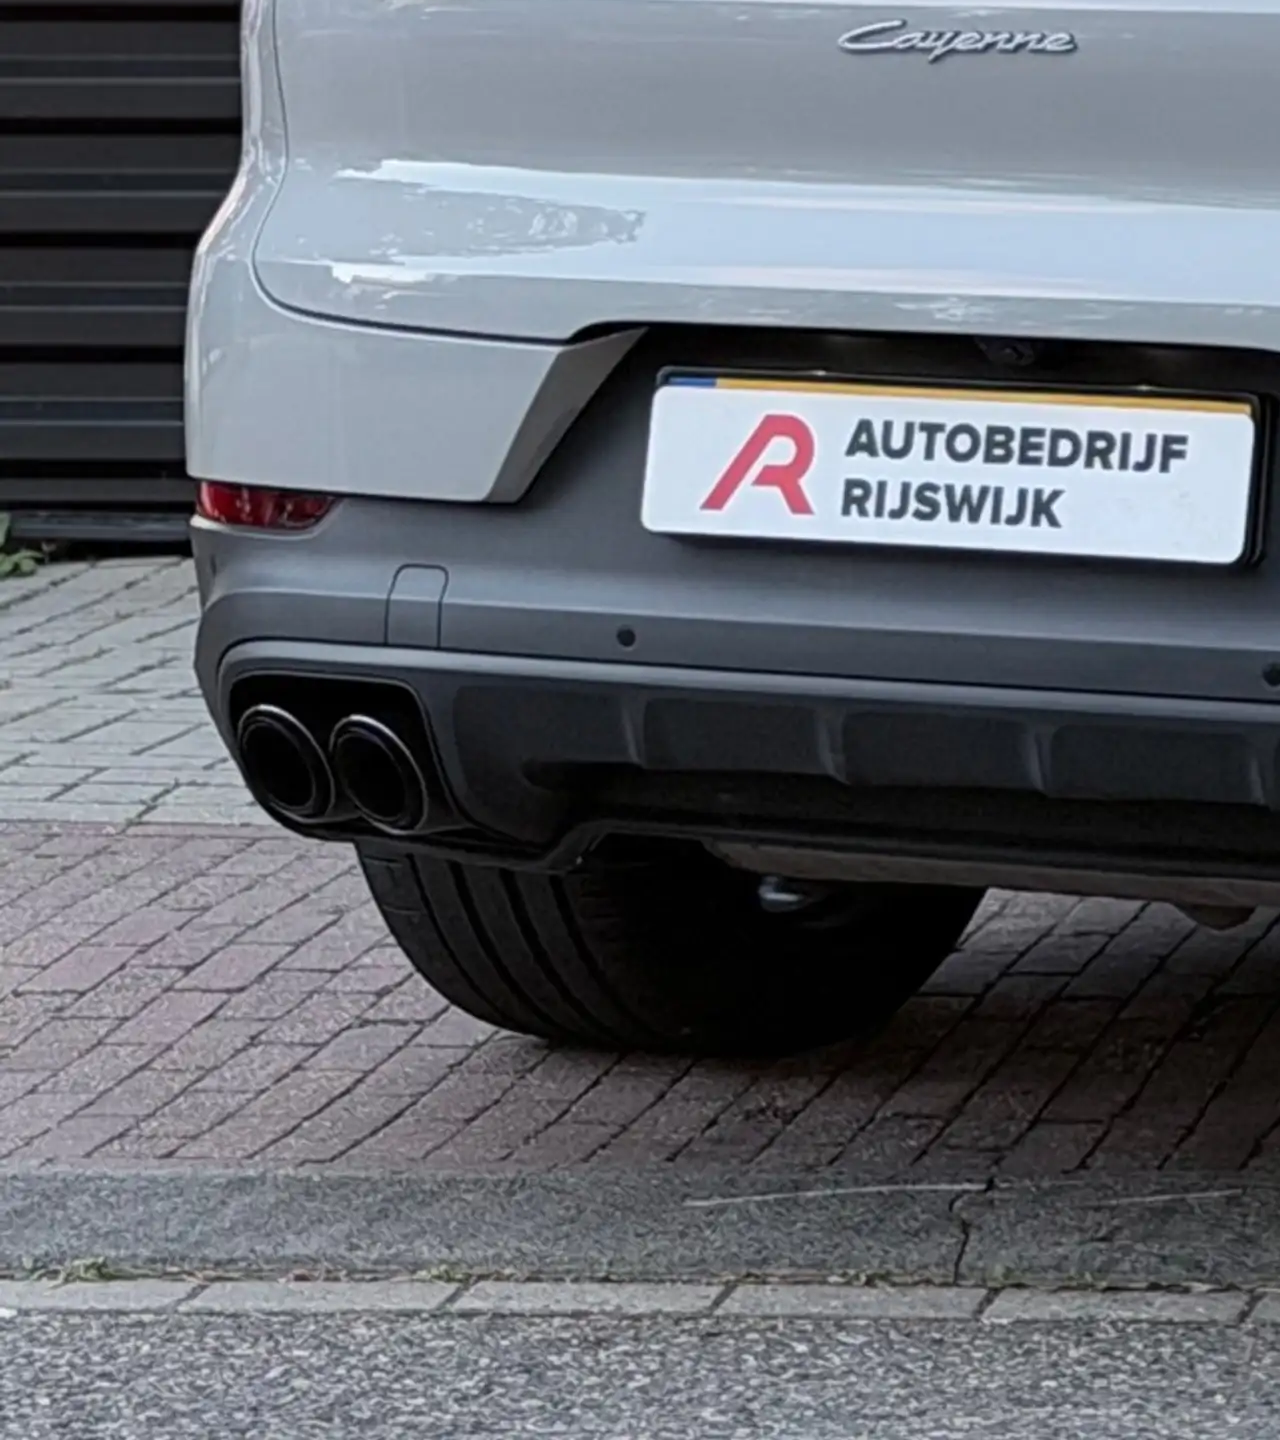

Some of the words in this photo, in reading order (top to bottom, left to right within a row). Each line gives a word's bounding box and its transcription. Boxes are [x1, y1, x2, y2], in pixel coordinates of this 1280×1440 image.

[838, 20, 1079, 63] Cayenne
[845, 419, 1189, 474] AUTOBEDRIJF
[840, 478, 1065, 528] RIJSWIJK
